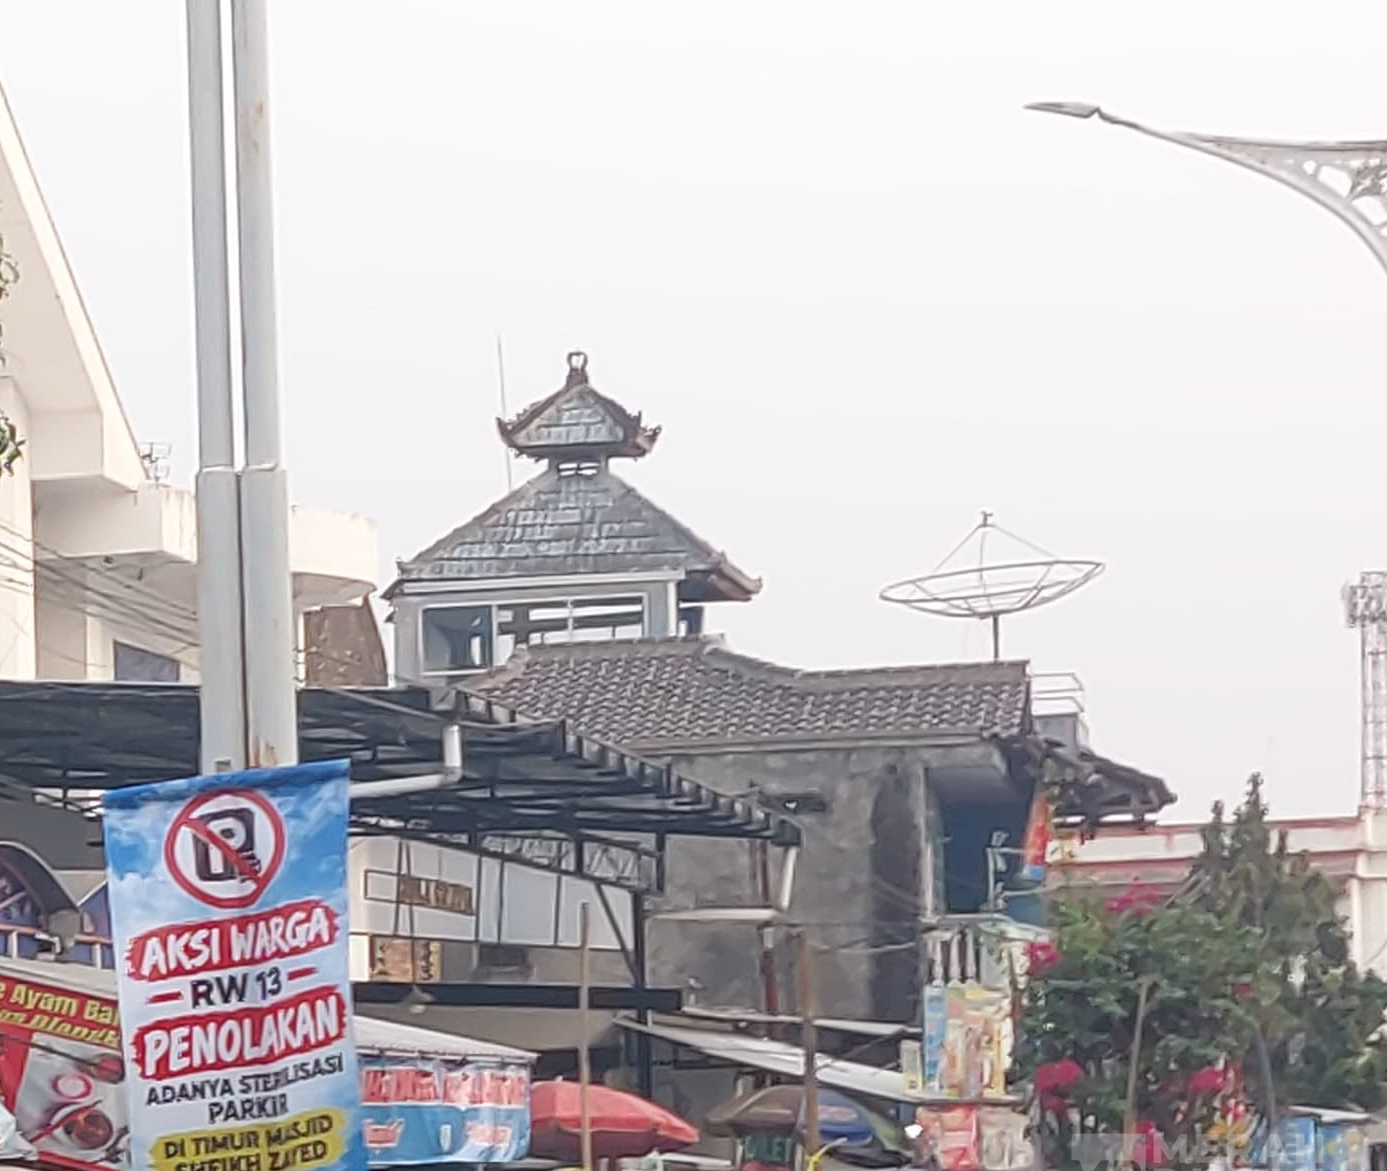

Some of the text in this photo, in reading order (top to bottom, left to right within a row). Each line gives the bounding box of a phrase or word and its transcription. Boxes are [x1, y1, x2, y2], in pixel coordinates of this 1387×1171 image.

[140, 906, 330, 977] AKSI WARGA
[10, 984, 78, 1019] Ayam
[190, 965, 283, 1010] RW 13
[143, 994, 340, 1077] PENOLAKAN
[145, 1076, 236, 1107] ADANYA
[208, 1093, 289, 1125] PARKIR
[163, 1139, 187, 1160] DI
[190, 1129, 260, 1156] TIMUR
